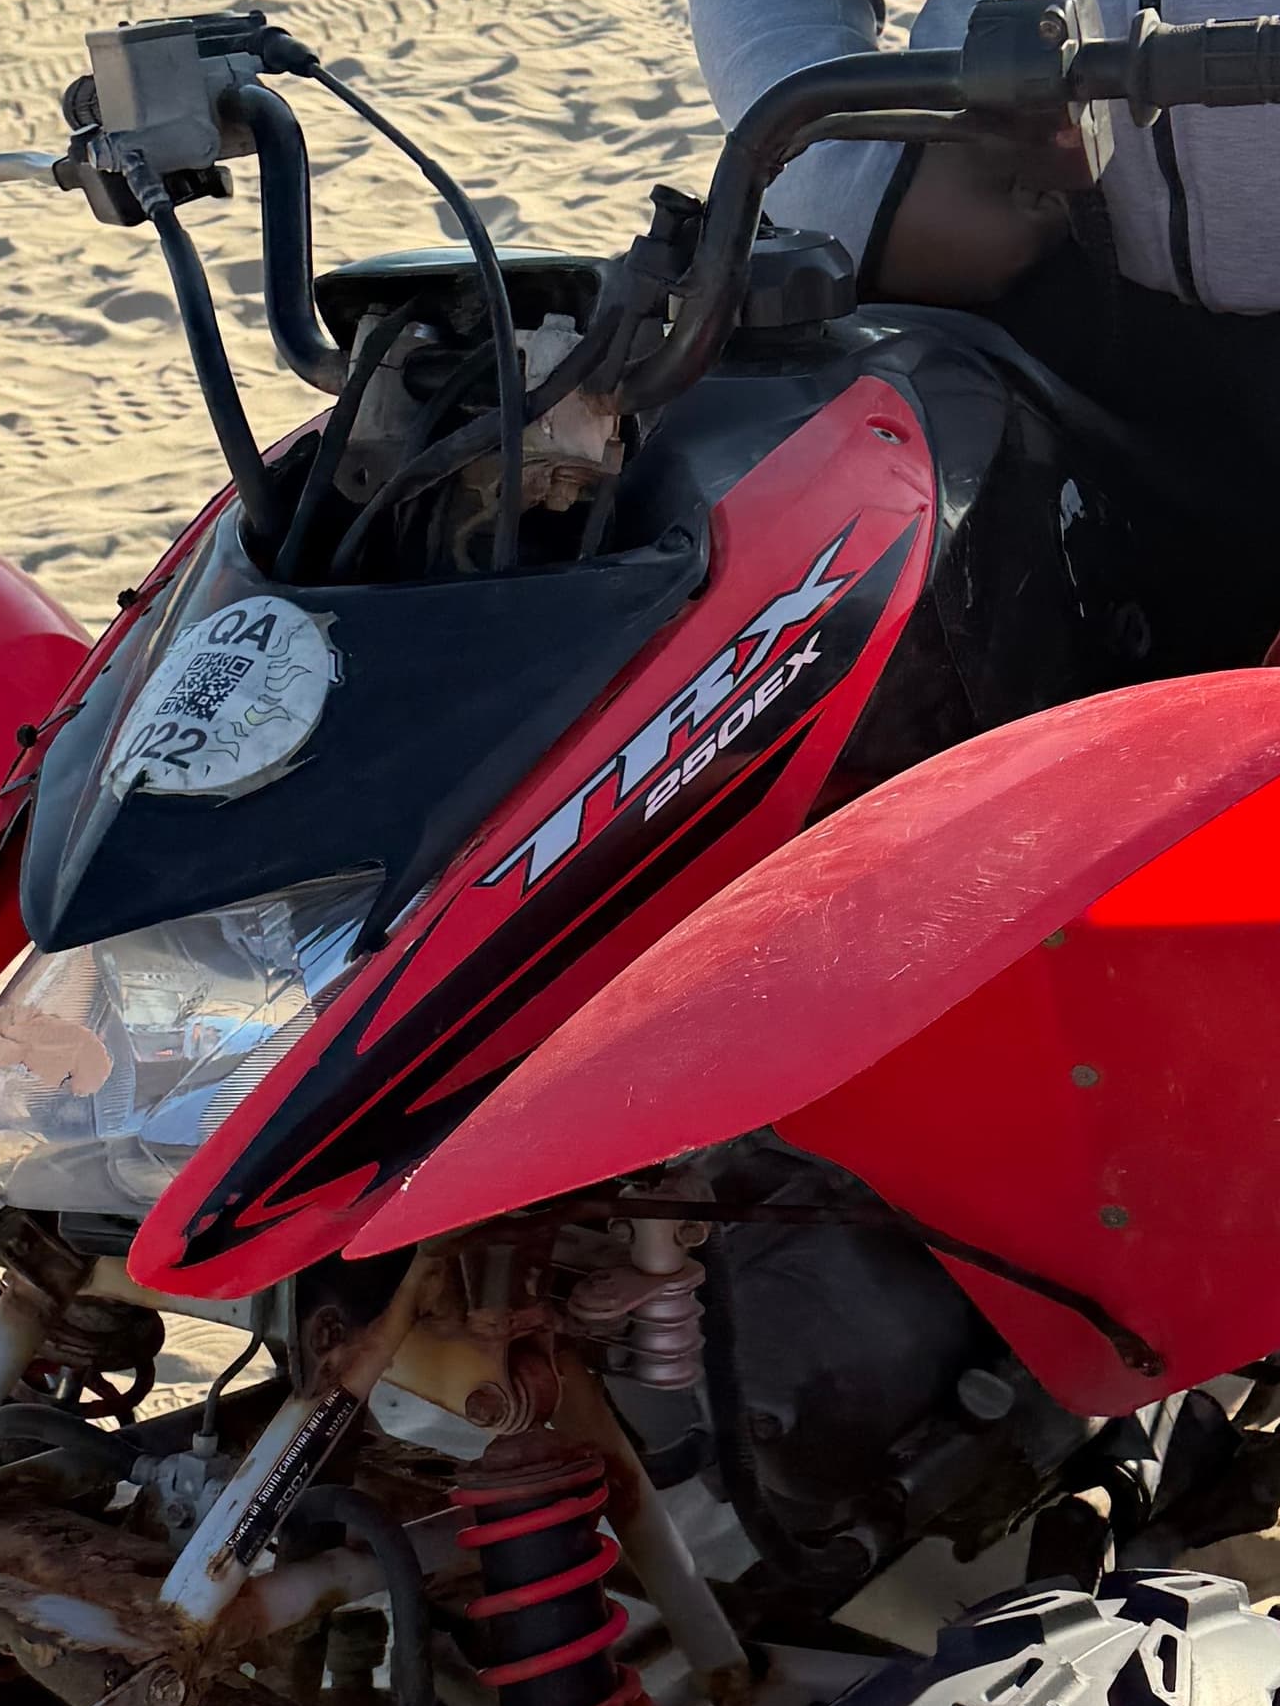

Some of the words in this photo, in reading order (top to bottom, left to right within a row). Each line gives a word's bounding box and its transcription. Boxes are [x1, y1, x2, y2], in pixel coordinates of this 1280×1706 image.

[208, 609, 278, 652] QA
[125, 722, 208, 769] 022
[477, 528, 856, 889] TRX
[643, 630, 822, 821] 250EX
